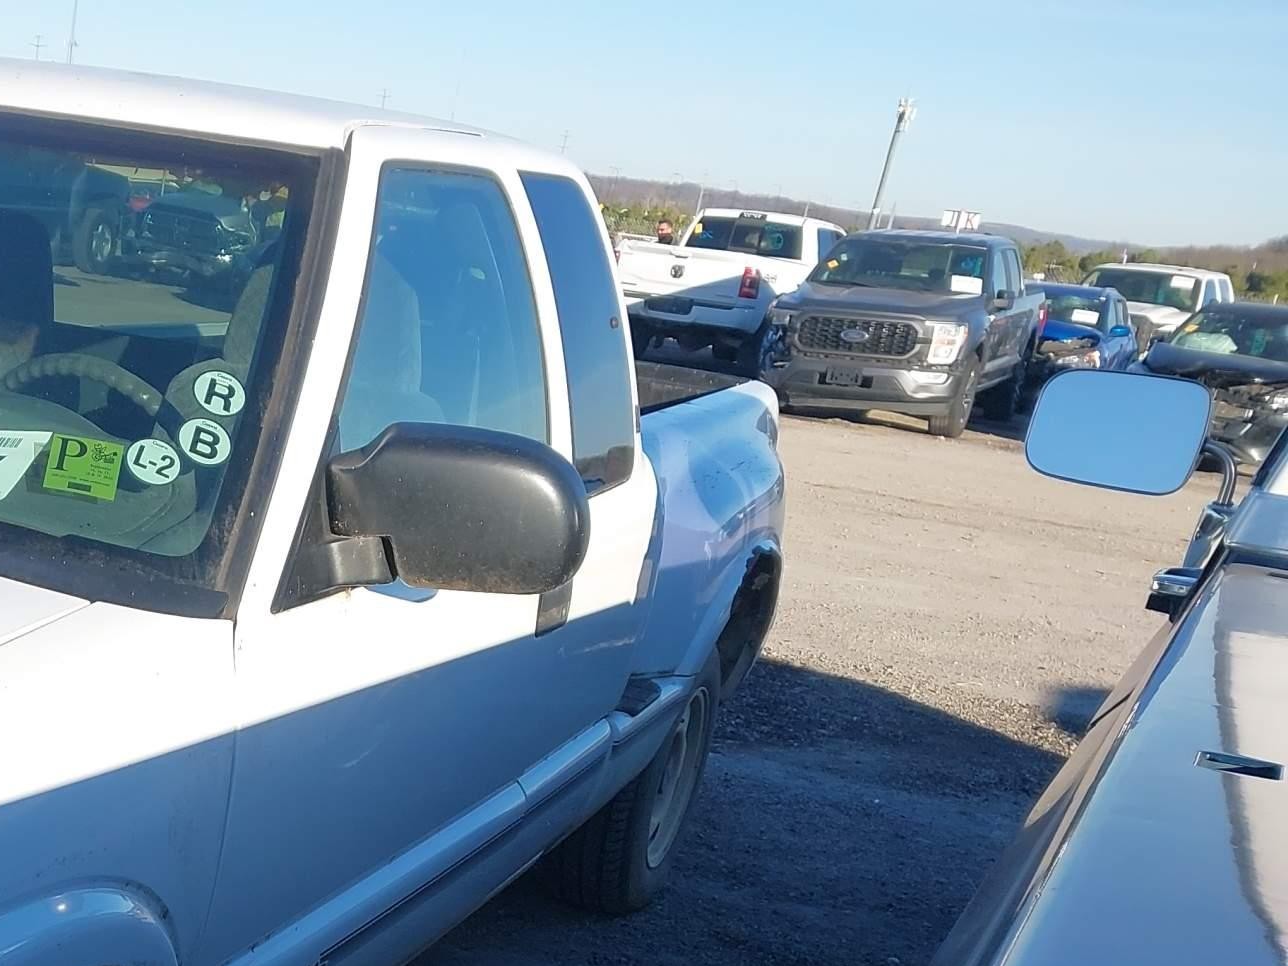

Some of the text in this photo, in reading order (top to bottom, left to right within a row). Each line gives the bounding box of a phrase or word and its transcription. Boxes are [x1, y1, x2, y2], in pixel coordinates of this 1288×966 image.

[204, 377, 237, 413] R
[48, 436, 88, 471] P
[188, 425, 221, 460] B
[132, 445, 175, 479] L-2
